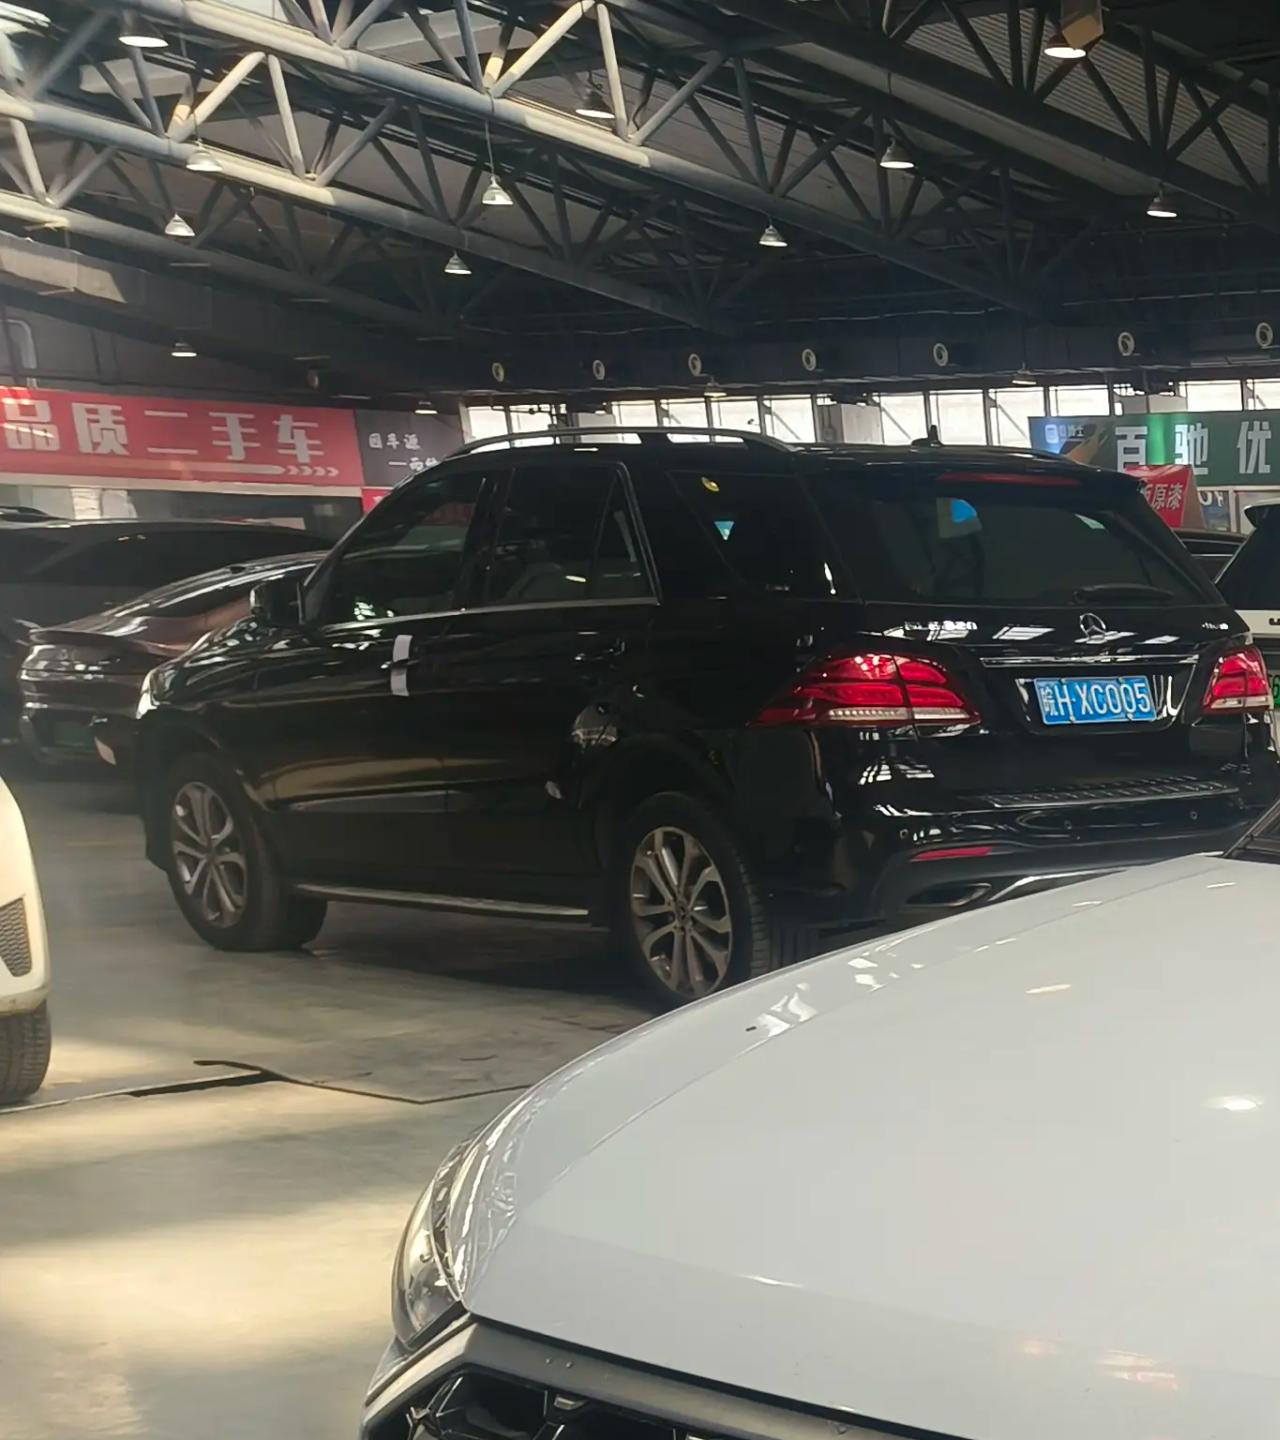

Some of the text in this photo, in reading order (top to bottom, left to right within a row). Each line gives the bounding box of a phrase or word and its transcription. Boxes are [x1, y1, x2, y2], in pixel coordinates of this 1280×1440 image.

[2, 397, 325, 463] 品质二手车
